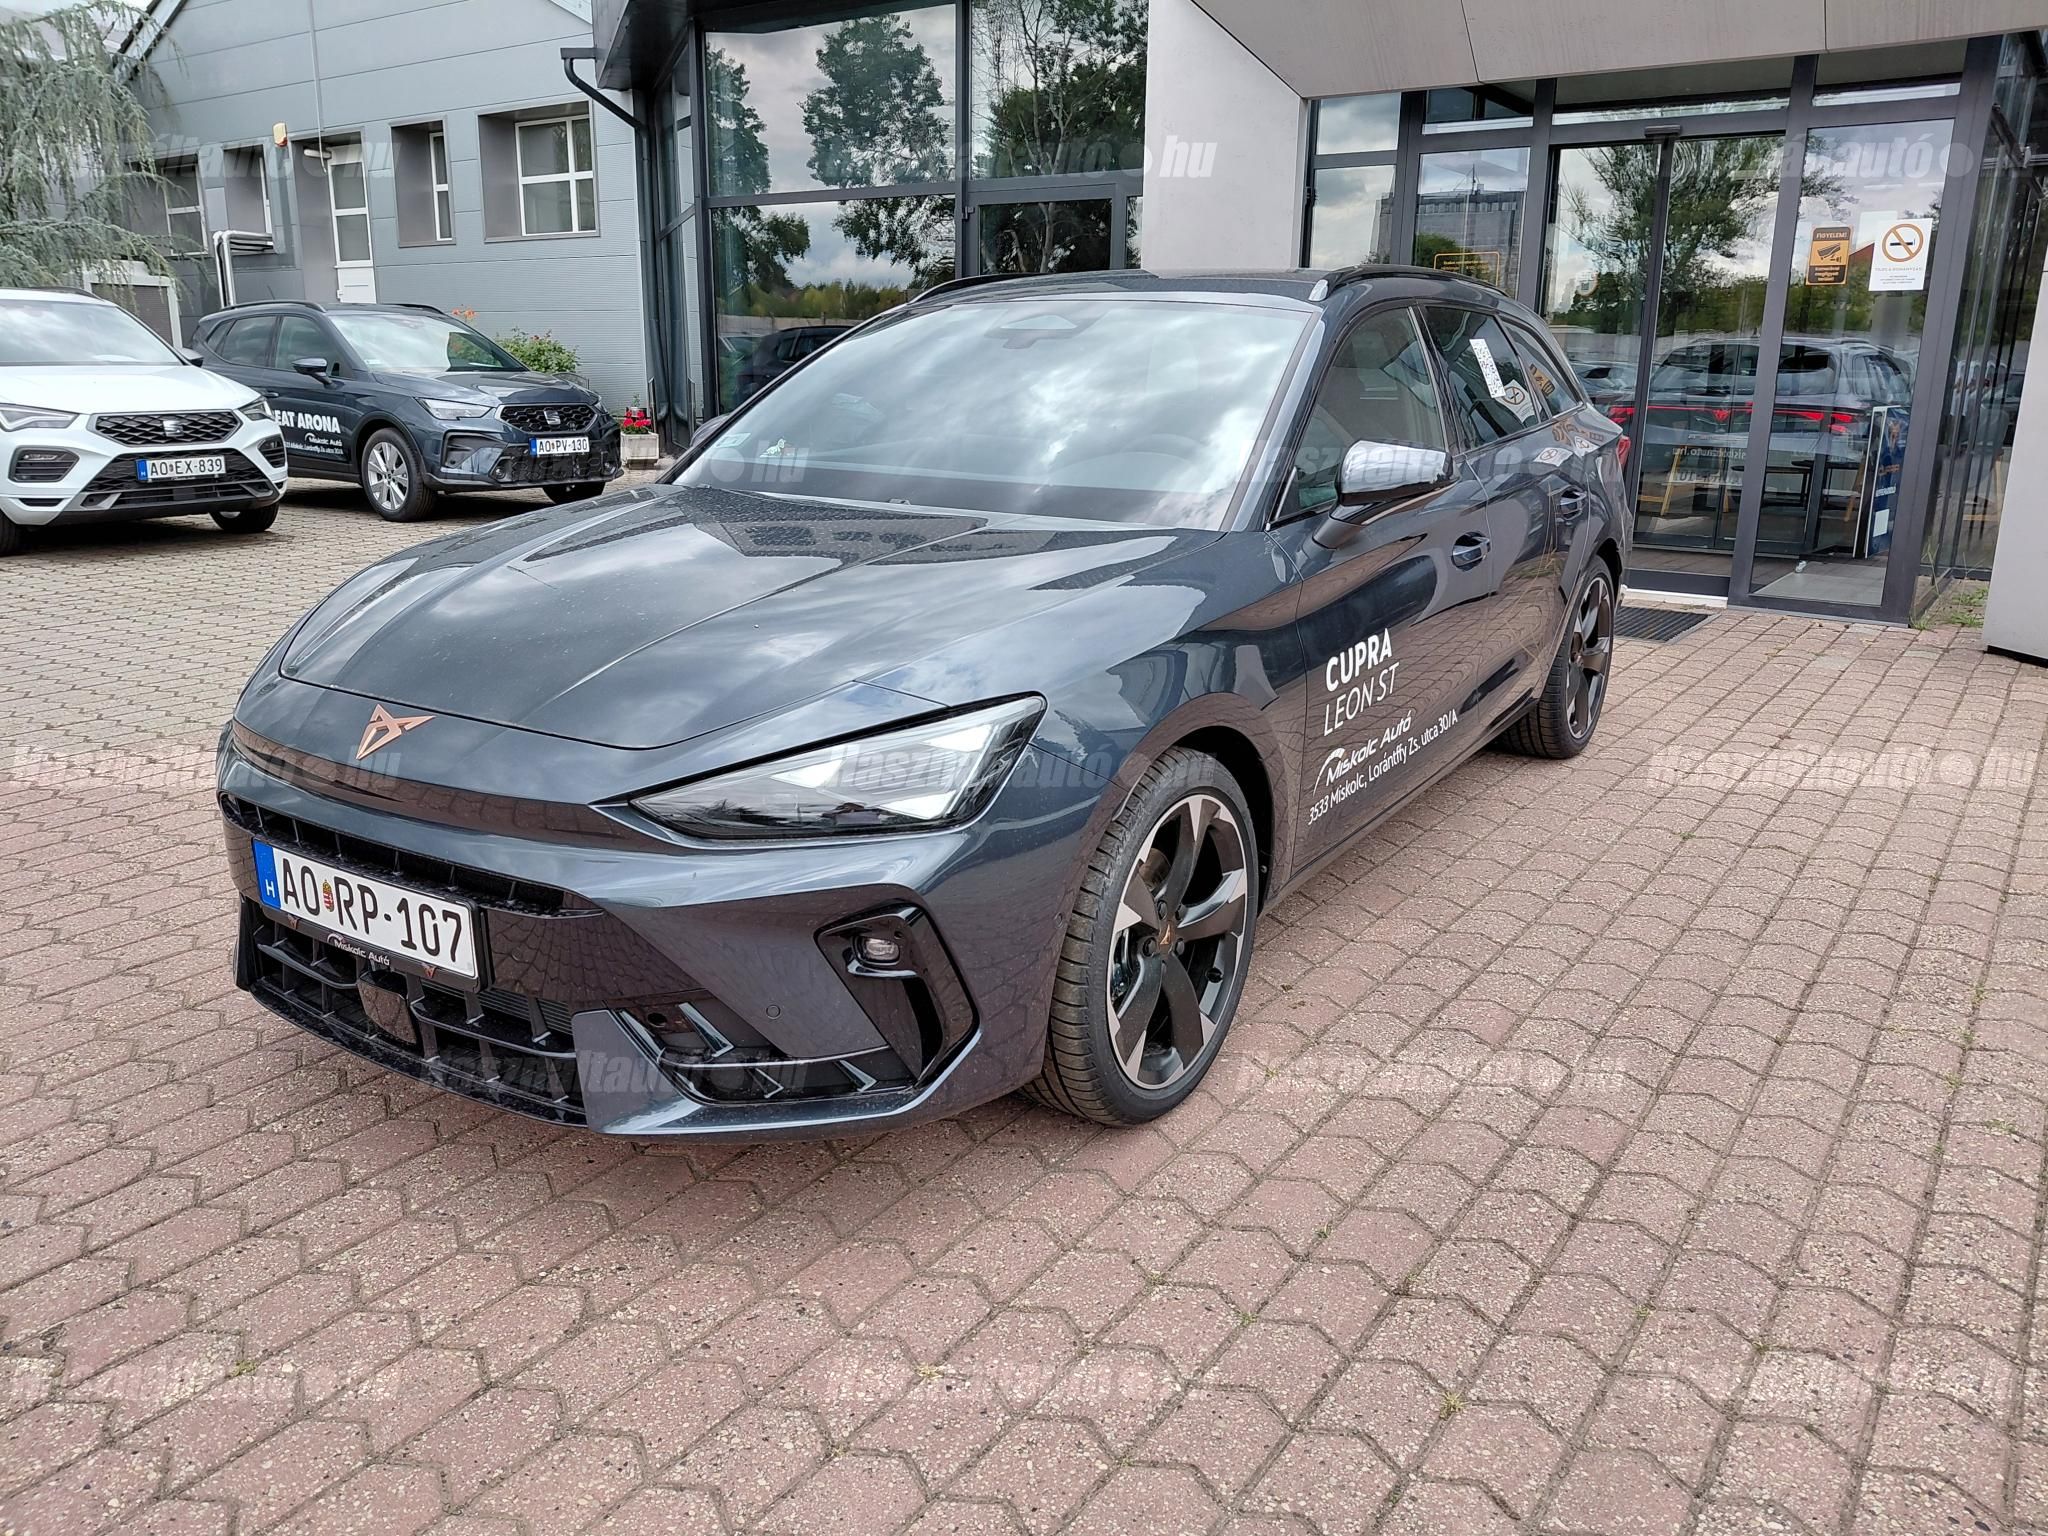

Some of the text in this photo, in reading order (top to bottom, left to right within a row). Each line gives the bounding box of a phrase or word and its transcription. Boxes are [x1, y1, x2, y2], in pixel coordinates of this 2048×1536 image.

[297, 412, 341, 434] ARONA
[150, 458, 223, 476] AO EX-839
[1325, 627, 1393, 692] CUPRA
[1323, 662, 1400, 737] LEON ST
[1308, 708, 1459, 826] 3533 Miskolc, Lorántffy Zs. utca 30/A
[1325, 709, 1412, 787] Miskolc Autó
[265, 879, 276, 899] H
[282, 857, 463, 963] AO RP-107
[334, 939, 390, 966] Miskolc Autó
